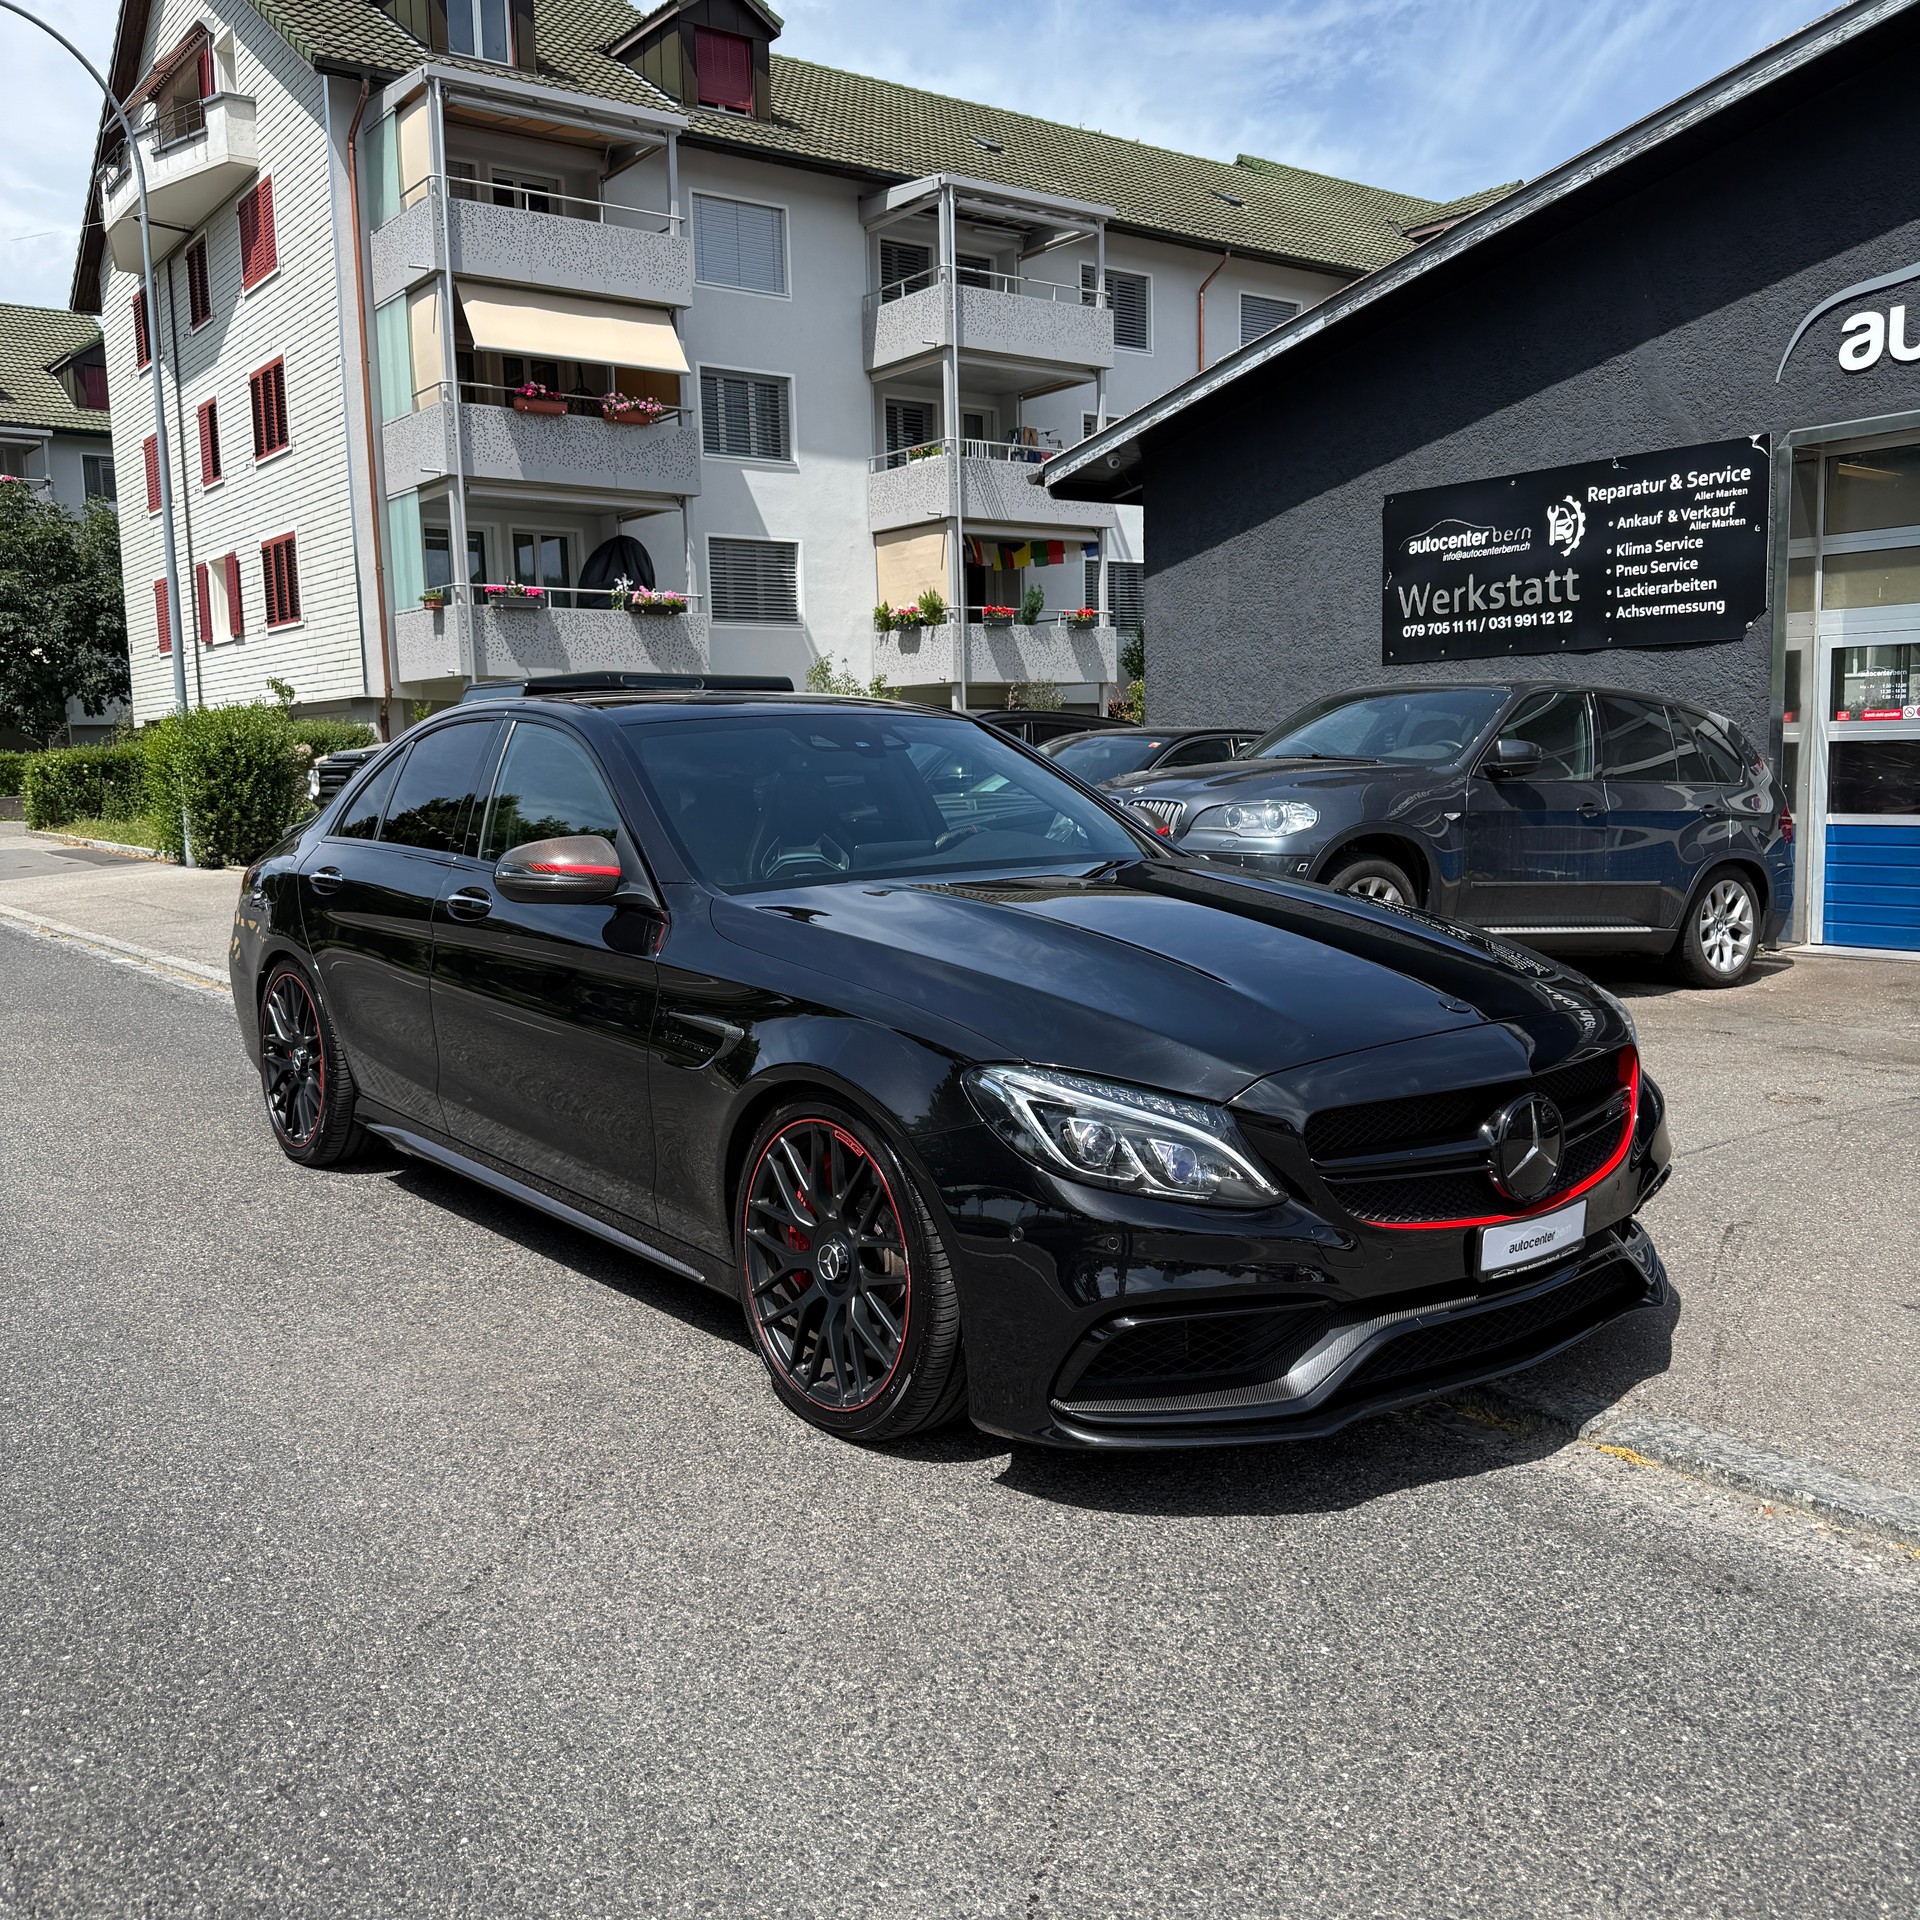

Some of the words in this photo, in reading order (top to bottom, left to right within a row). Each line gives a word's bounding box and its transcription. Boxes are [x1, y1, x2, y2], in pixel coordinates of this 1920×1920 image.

[1587, 479, 1667, 504] Reparatur
[1669, 473, 1683, 491] &
[1686, 465, 1752, 488] Service
[1694, 491, 1715, 502] Aller
[1716, 487, 1749, 499] Marken
[1616, 510, 1664, 529] Ankauf
[1667, 510, 1679, 523] &
[1680, 501, 1736, 521] Verkauf
[1689, 521, 1710, 532] Aller
[1711, 517, 1747, 529] Marken
[1442, 541, 1531, 562] info@autocenterbern.ch
[1616, 541, 1653, 557] Klima
[1654, 536, 1704, 554] Service
[1615, 563, 1648, 578] Pneu
[1650, 557, 1699, 574] Service
[1398, 567, 1581, 619] Werkstatt
[1616, 578, 1718, 599] Lackierarbeiten
[1615, 599, 1726, 619] Achsvermessung
[1402, 624, 1426, 638] 079
[1427, 621, 1451, 636] 705
[1452, 620, 1464, 633] 11
[1465, 619, 1477, 632] 11
[1479, 616, 1486, 633] /
[1488, 616, 1512, 630] 031
[1514, 613, 1538, 627] 991
[1540, 611, 1556, 625] 12
[1557, 609, 1574, 624] 12
